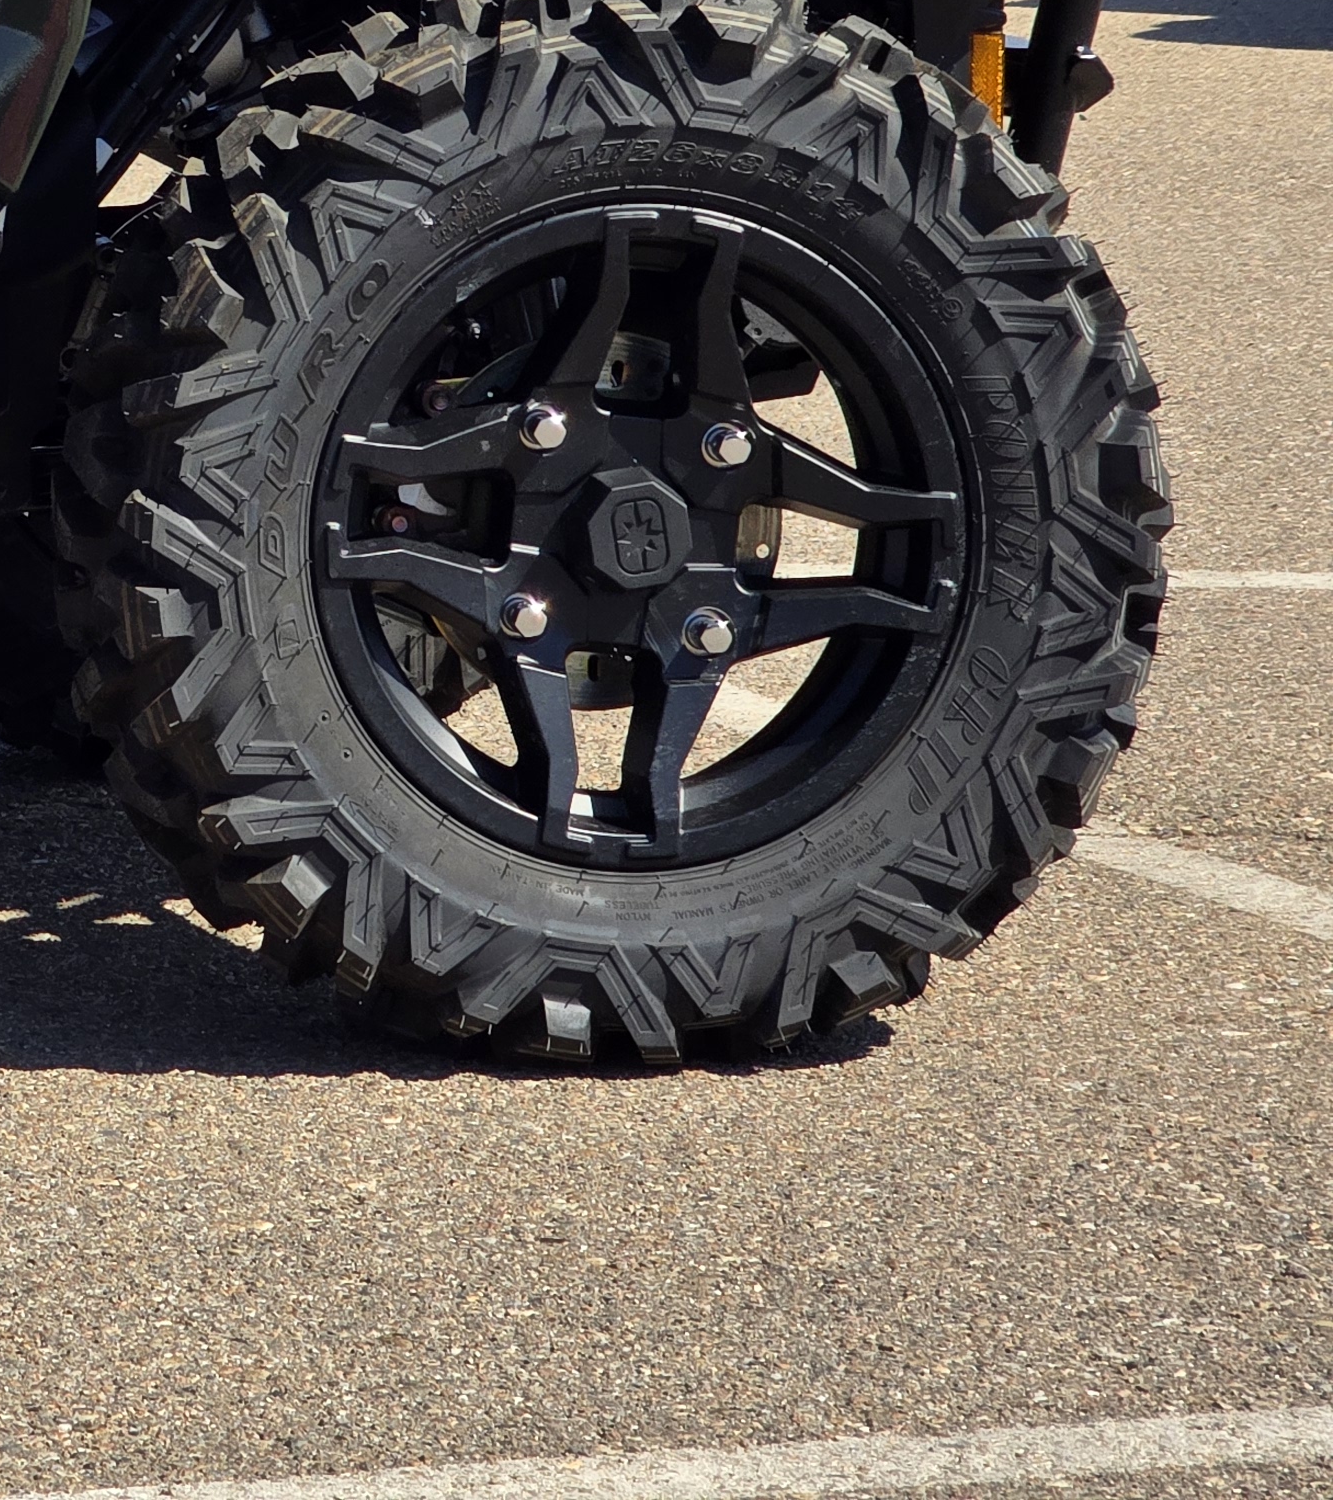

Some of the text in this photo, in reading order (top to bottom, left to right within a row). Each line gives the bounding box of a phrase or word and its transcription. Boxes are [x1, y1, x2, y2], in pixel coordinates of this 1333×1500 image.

[256, 254, 398, 582] DURO
[887, 358, 1038, 816] POWER GRIP
